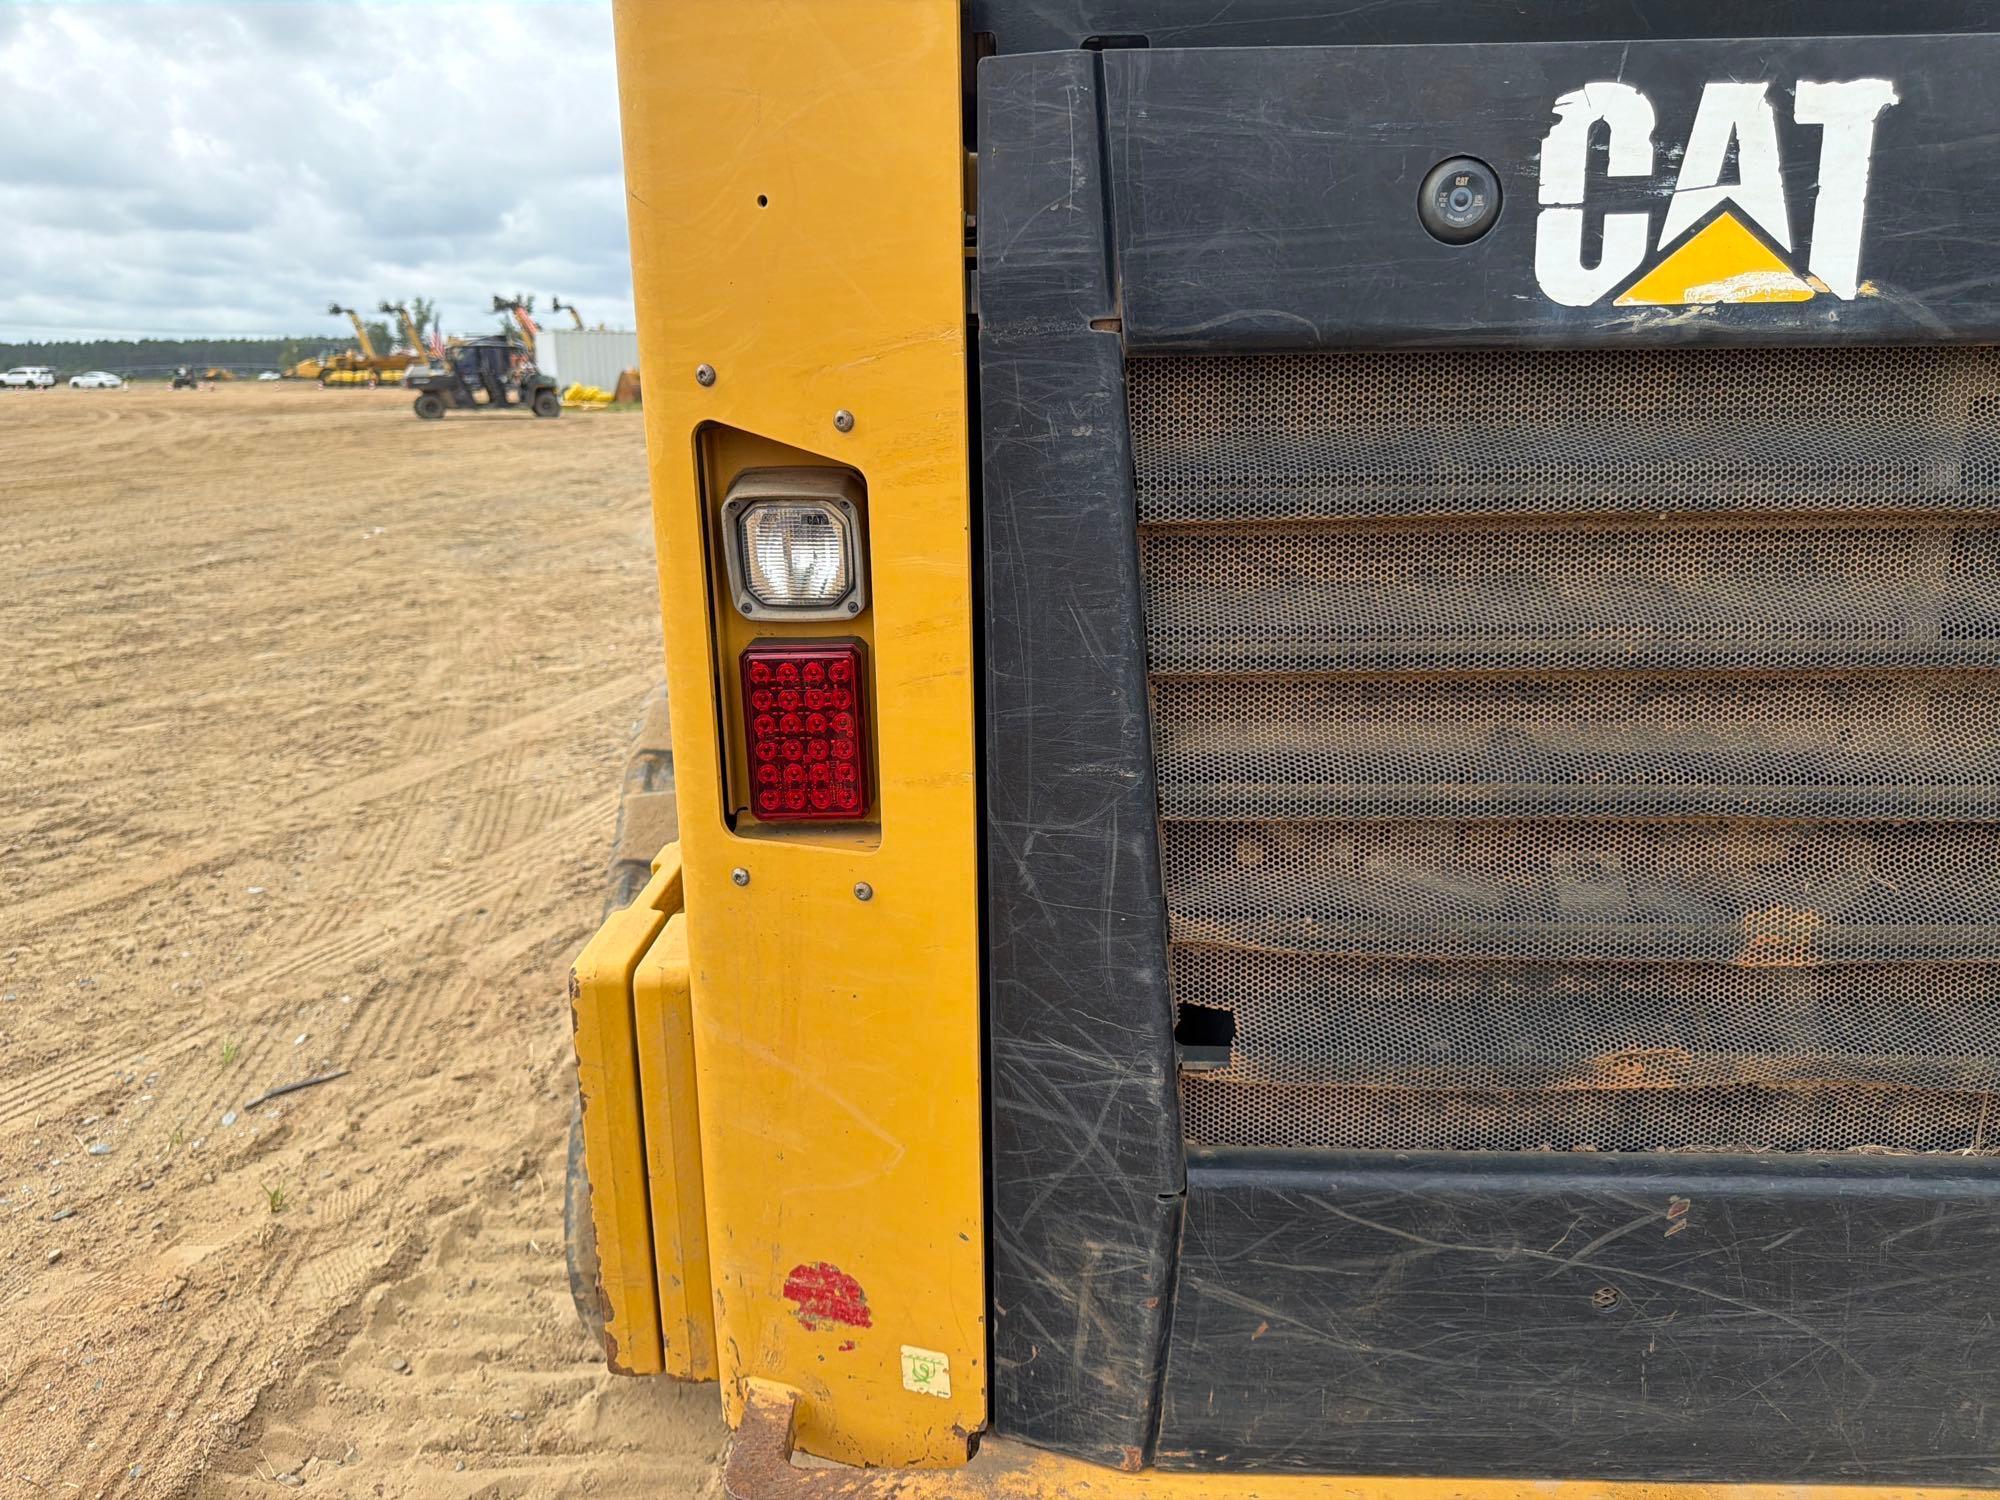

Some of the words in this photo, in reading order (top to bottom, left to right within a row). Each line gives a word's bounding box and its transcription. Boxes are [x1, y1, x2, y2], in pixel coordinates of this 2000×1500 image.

[1455, 176, 1470, 186] CAT
[1535, 79, 1900, 306] CAT
[807, 514, 824, 525] CAT
